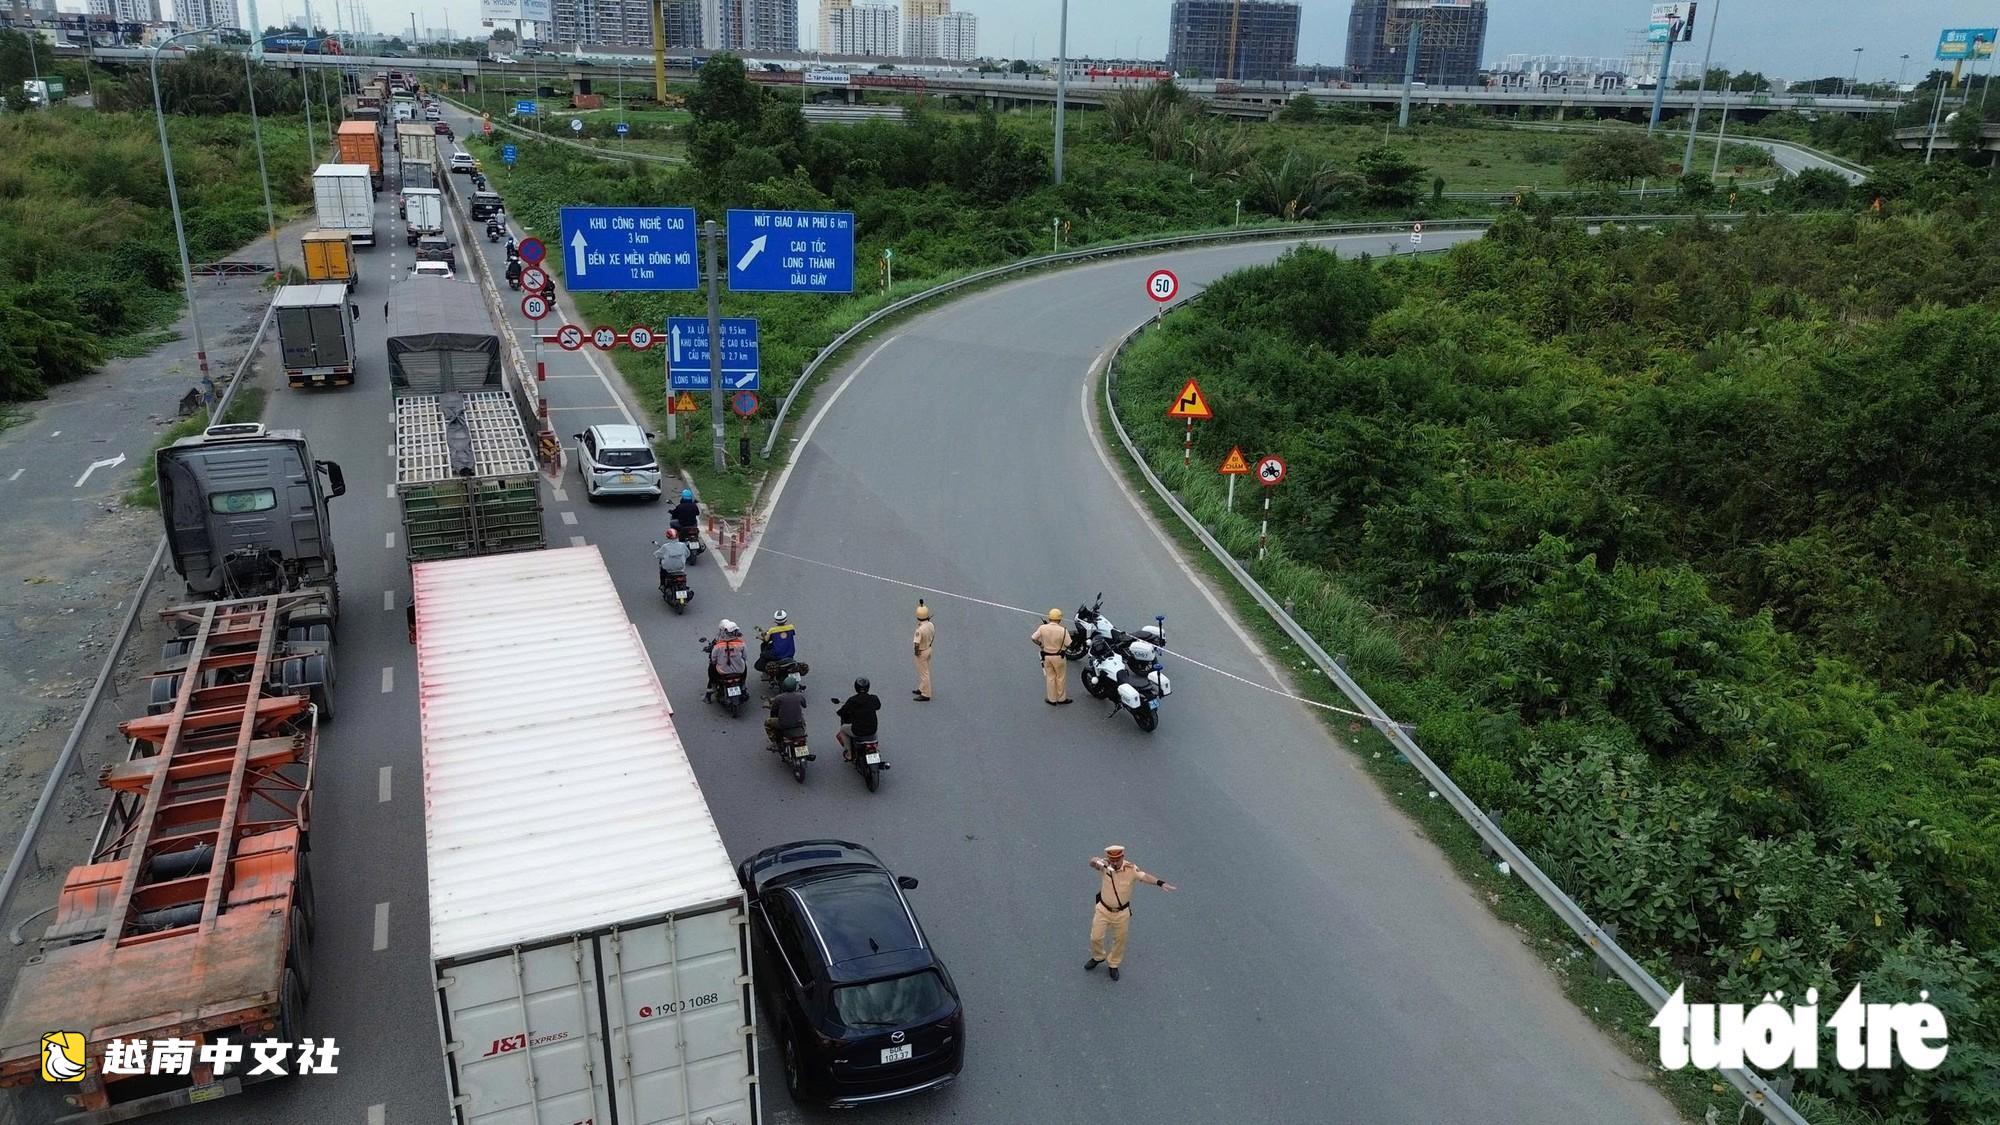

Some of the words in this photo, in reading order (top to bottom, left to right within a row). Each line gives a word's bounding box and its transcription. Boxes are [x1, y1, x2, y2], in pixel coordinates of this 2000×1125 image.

[590, 218, 606, 230] KHU
[612, 216, 634, 230] CÔNG
[640, 216, 661, 231] NGHỆ
[668, 218, 684, 230] CAO
[754, 213, 770, 227] NÚT
[774, 216, 793, 227] GIAO
[797, 217, 808, 228] AN
[812, 214, 828, 229] PHÚ
[830, 218, 835, 228] 6
[838, 218, 848, 229] km
[628, 233, 633, 244] 3
[635, 232, 649, 244] km
[791, 241, 806, 252] CAO
[811, 237, 826, 252] TỐC
[588, 249, 605, 265] BẾN
[609, 253, 620, 265] XE
[624, 249, 644, 265] MIỀN
[649, 251, 671, 265] ĐÔNG
[675, 250, 690, 265] MỚI
[783, 257, 803, 268] LONG
[809, 256, 835, 269] THÀNH
[630, 268, 638, 279] 12
[640, 268, 654, 279] km
[791, 270, 806, 285] DẦU
[1155, 279, 1170, 293] 50
[529, 302, 540, 312] 60
[688, 326, 695, 334] XA
[698, 324, 704, 335] LỘ
[738, 326, 746, 334] km
[635, 333, 647, 343] 50
[694, 337, 708, 347] CÔNG
[728, 339, 738, 347] CAO
[749, 339, 757, 347] km
[729, 352, 737, 360] 2.7
[740, 352, 748, 360] km
[674, 376, 688, 384] LONG
[692, 374, 708, 384] THÀNH
[725, 376, 733, 384] km
[656, 1000, 685, 1015] 1900
[689, 993, 718, 1008] 1088
[483, 1033, 526, 1057] J&T
[530, 1032, 568, 1047] EXPRESS
